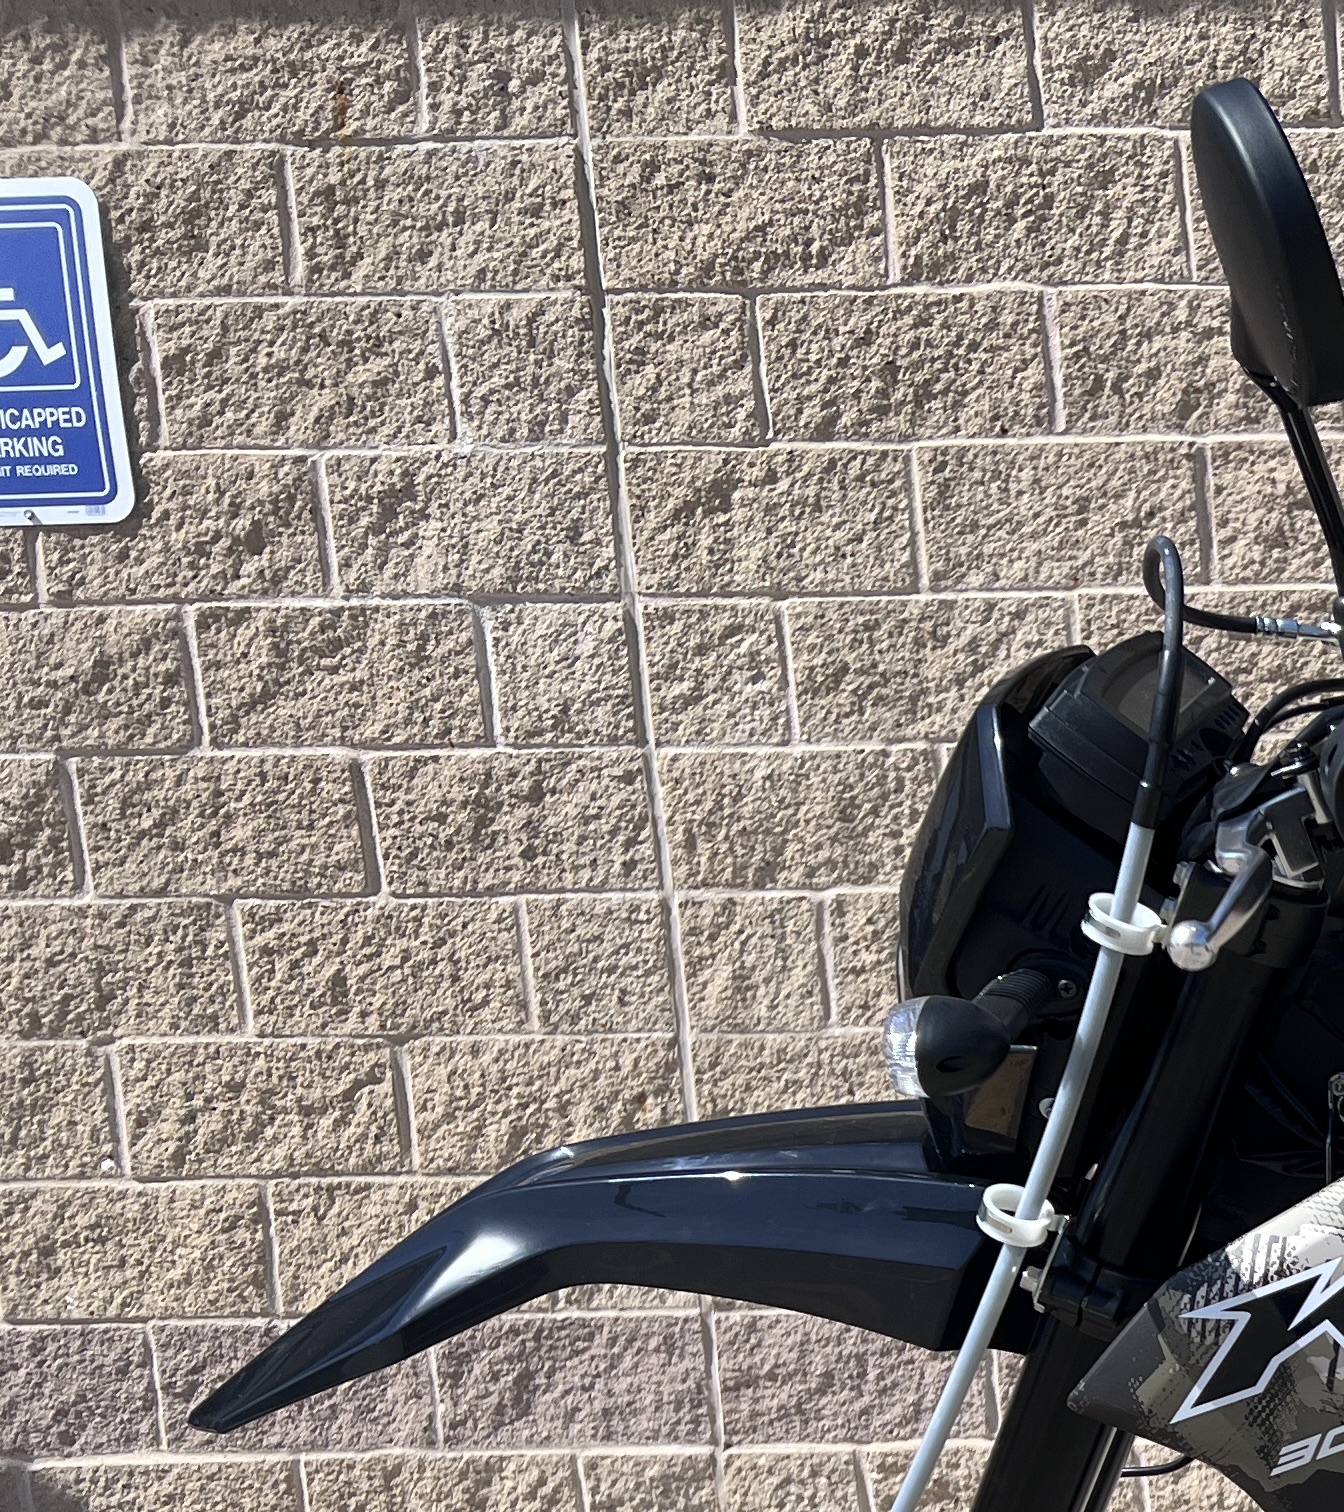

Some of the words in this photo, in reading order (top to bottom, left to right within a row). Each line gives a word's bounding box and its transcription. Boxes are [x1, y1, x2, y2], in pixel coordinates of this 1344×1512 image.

[0, 407, 86, 430] ICAPPED
[0, 436, 64, 457] RKING
[16, 464, 78, 476] REQUIRED
